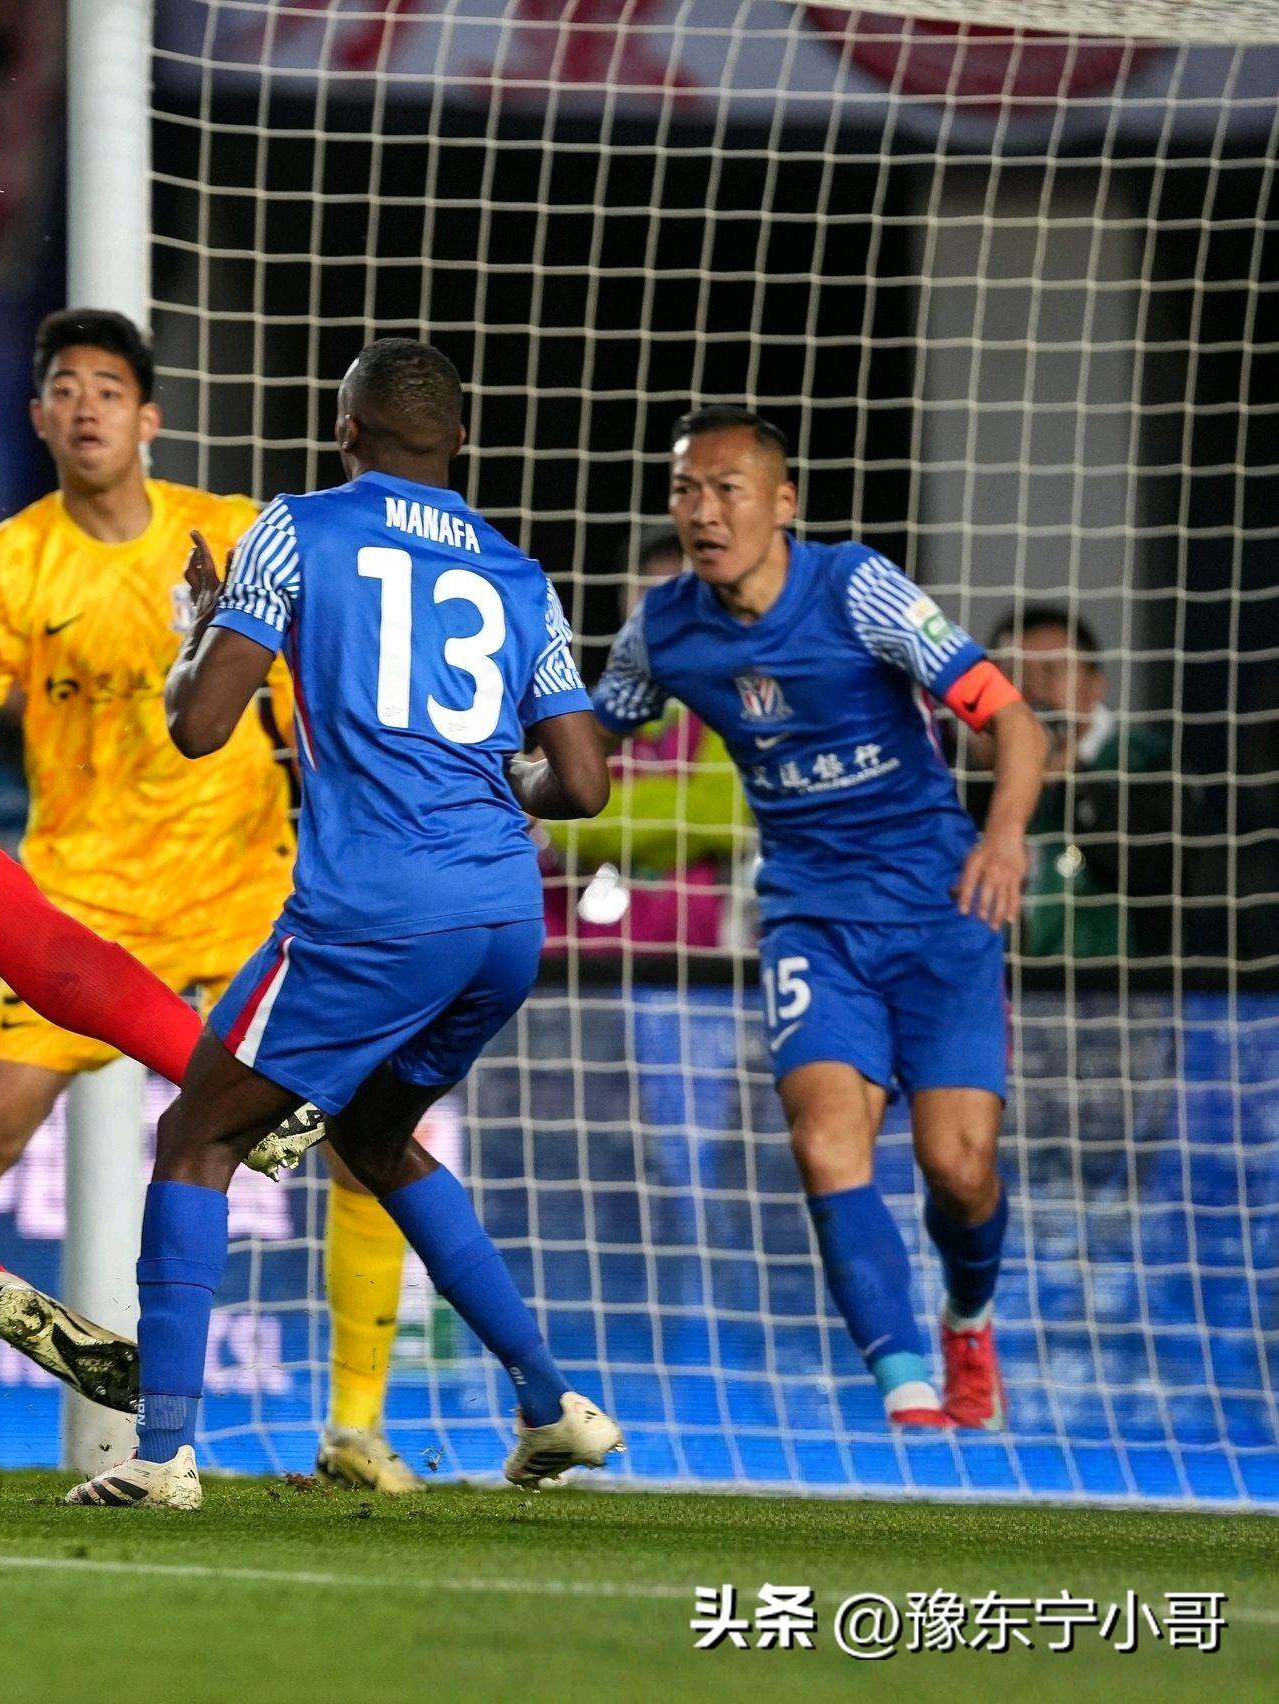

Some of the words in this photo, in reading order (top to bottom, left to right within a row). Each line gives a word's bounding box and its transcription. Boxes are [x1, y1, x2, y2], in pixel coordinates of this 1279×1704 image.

[385, 497, 481, 553] MANAFA
[357, 546, 506, 744] 13
[762, 956, 812, 1028] 15
